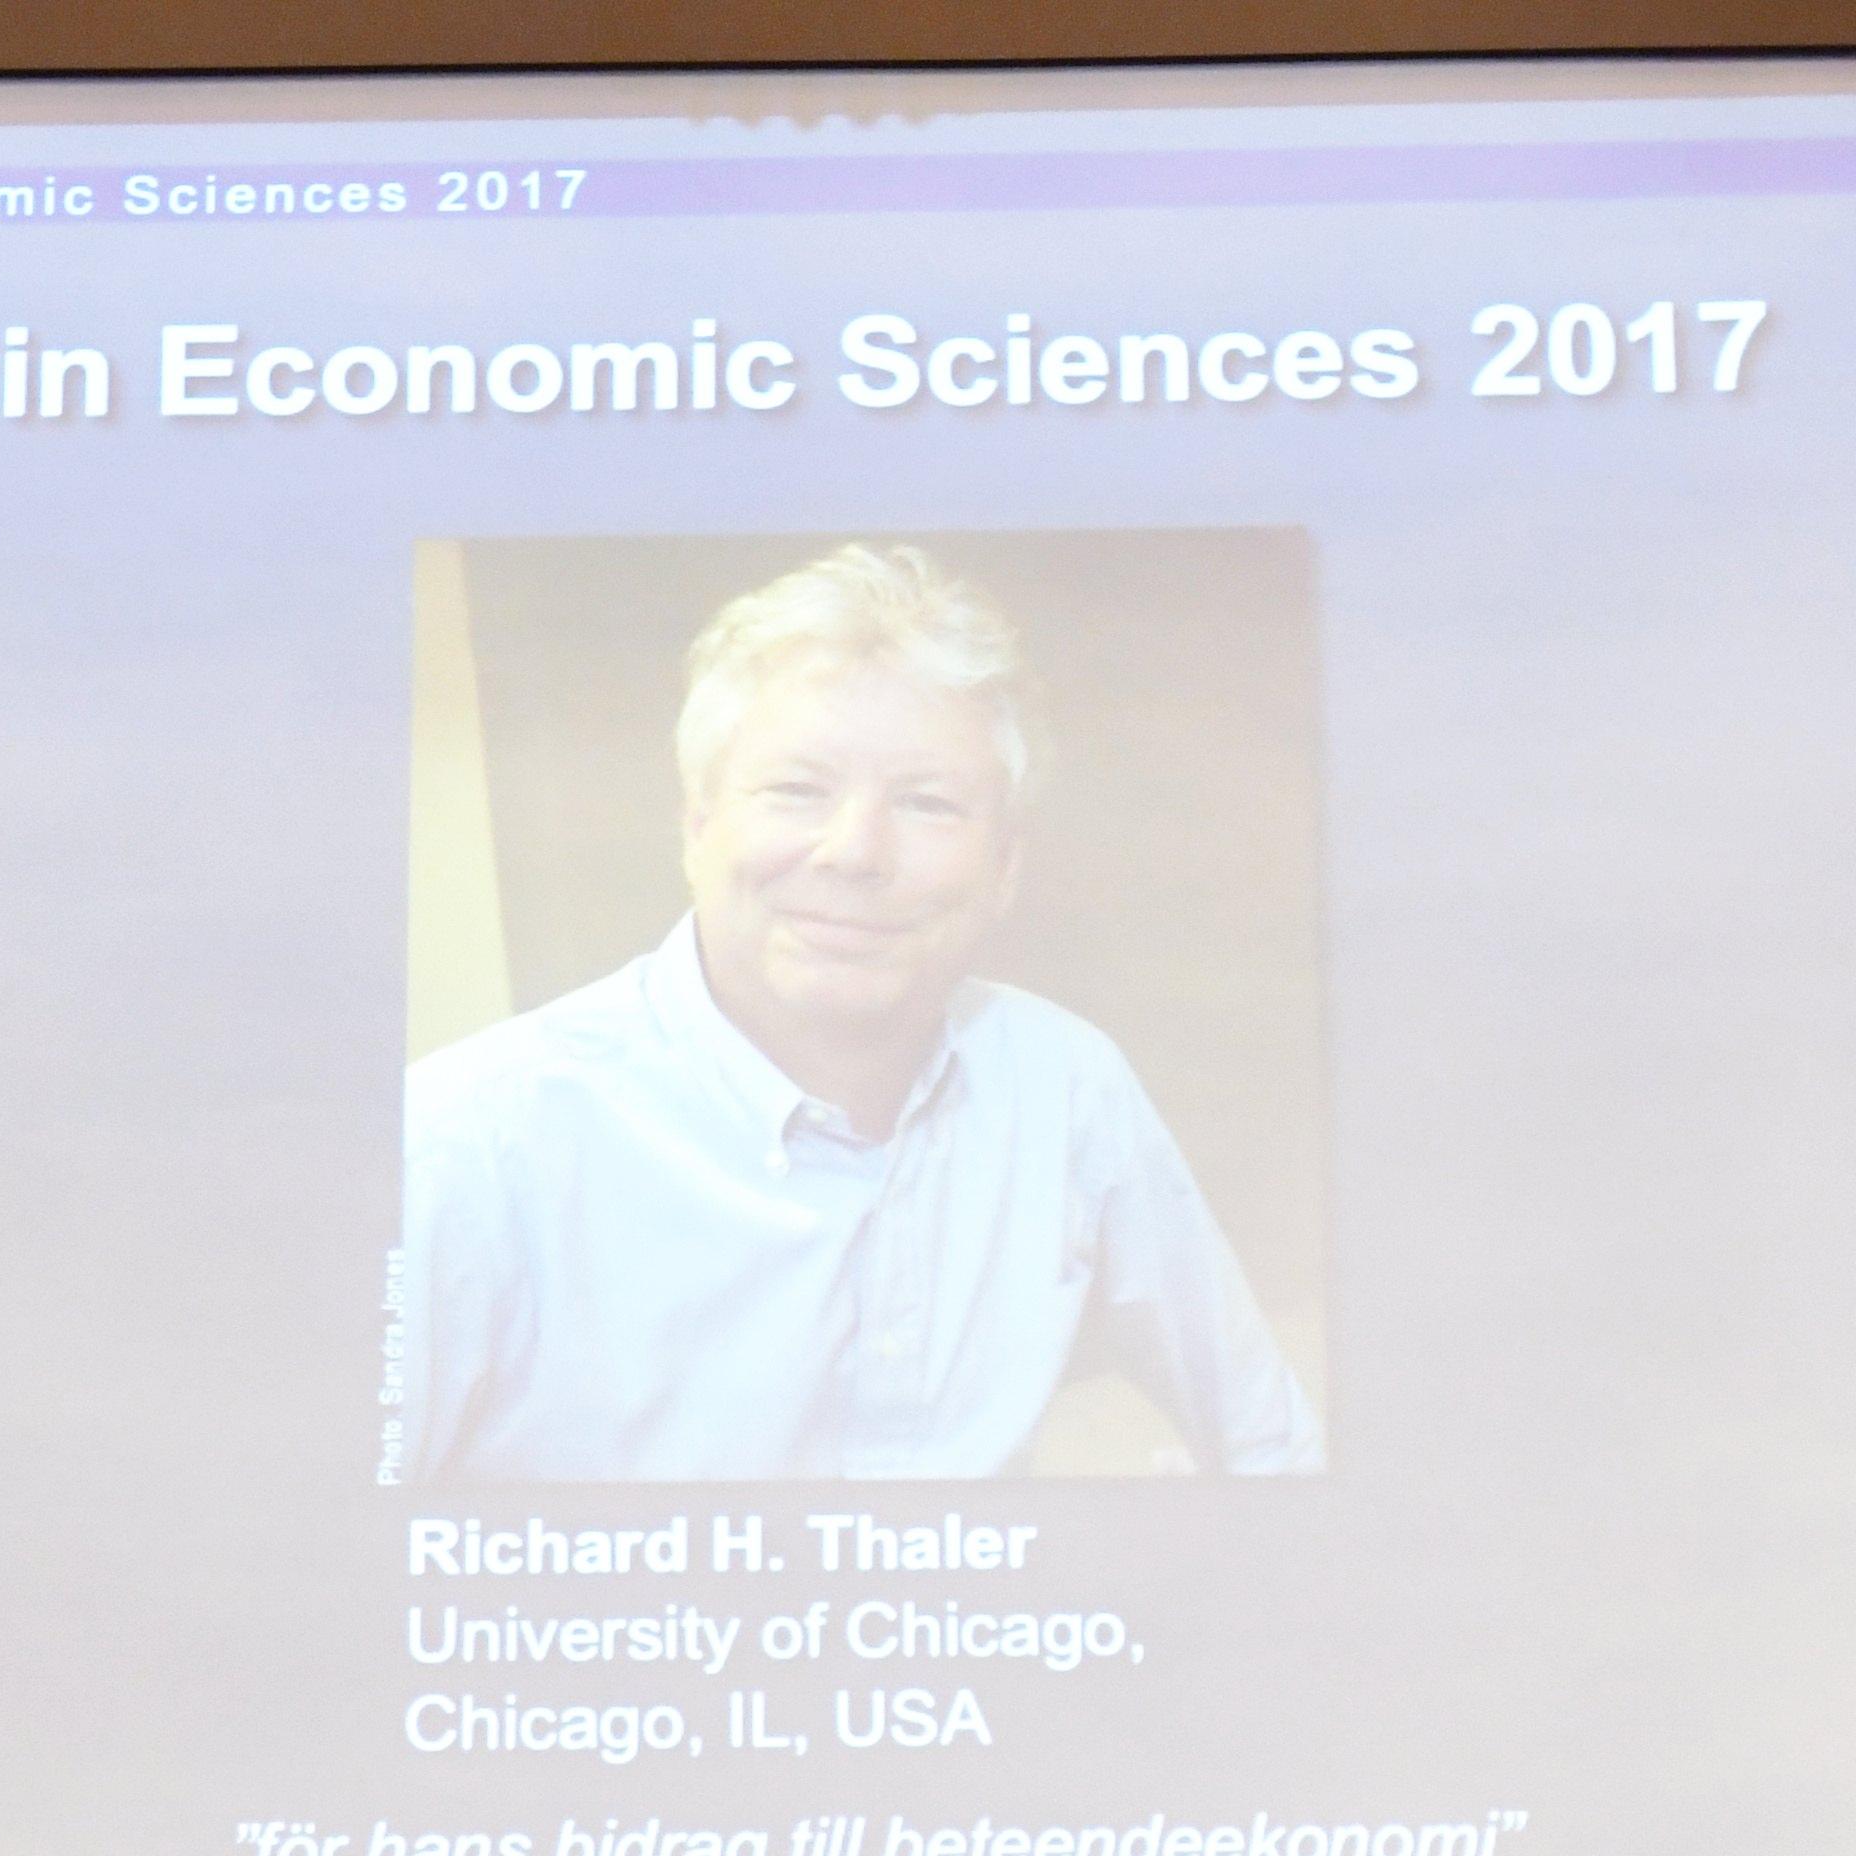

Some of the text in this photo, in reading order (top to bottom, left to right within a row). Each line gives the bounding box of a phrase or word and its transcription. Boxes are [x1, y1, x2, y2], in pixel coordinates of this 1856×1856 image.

[123, 174, 407, 215] Sciences
[436, 169, 587, 212] 2017
[3, 326, 109, 418] in
[160, 318, 796, 416] Economic
[837, 313, 1418, 408] Sciences
[1471, 299, 1767, 396] 2017
[409, 1512, 1038, 1576] Richard H. Thaler
[408, 1600, 1145, 1675] University of Chicago,
[404, 1688, 993, 1765] Chicago, IL, USA
